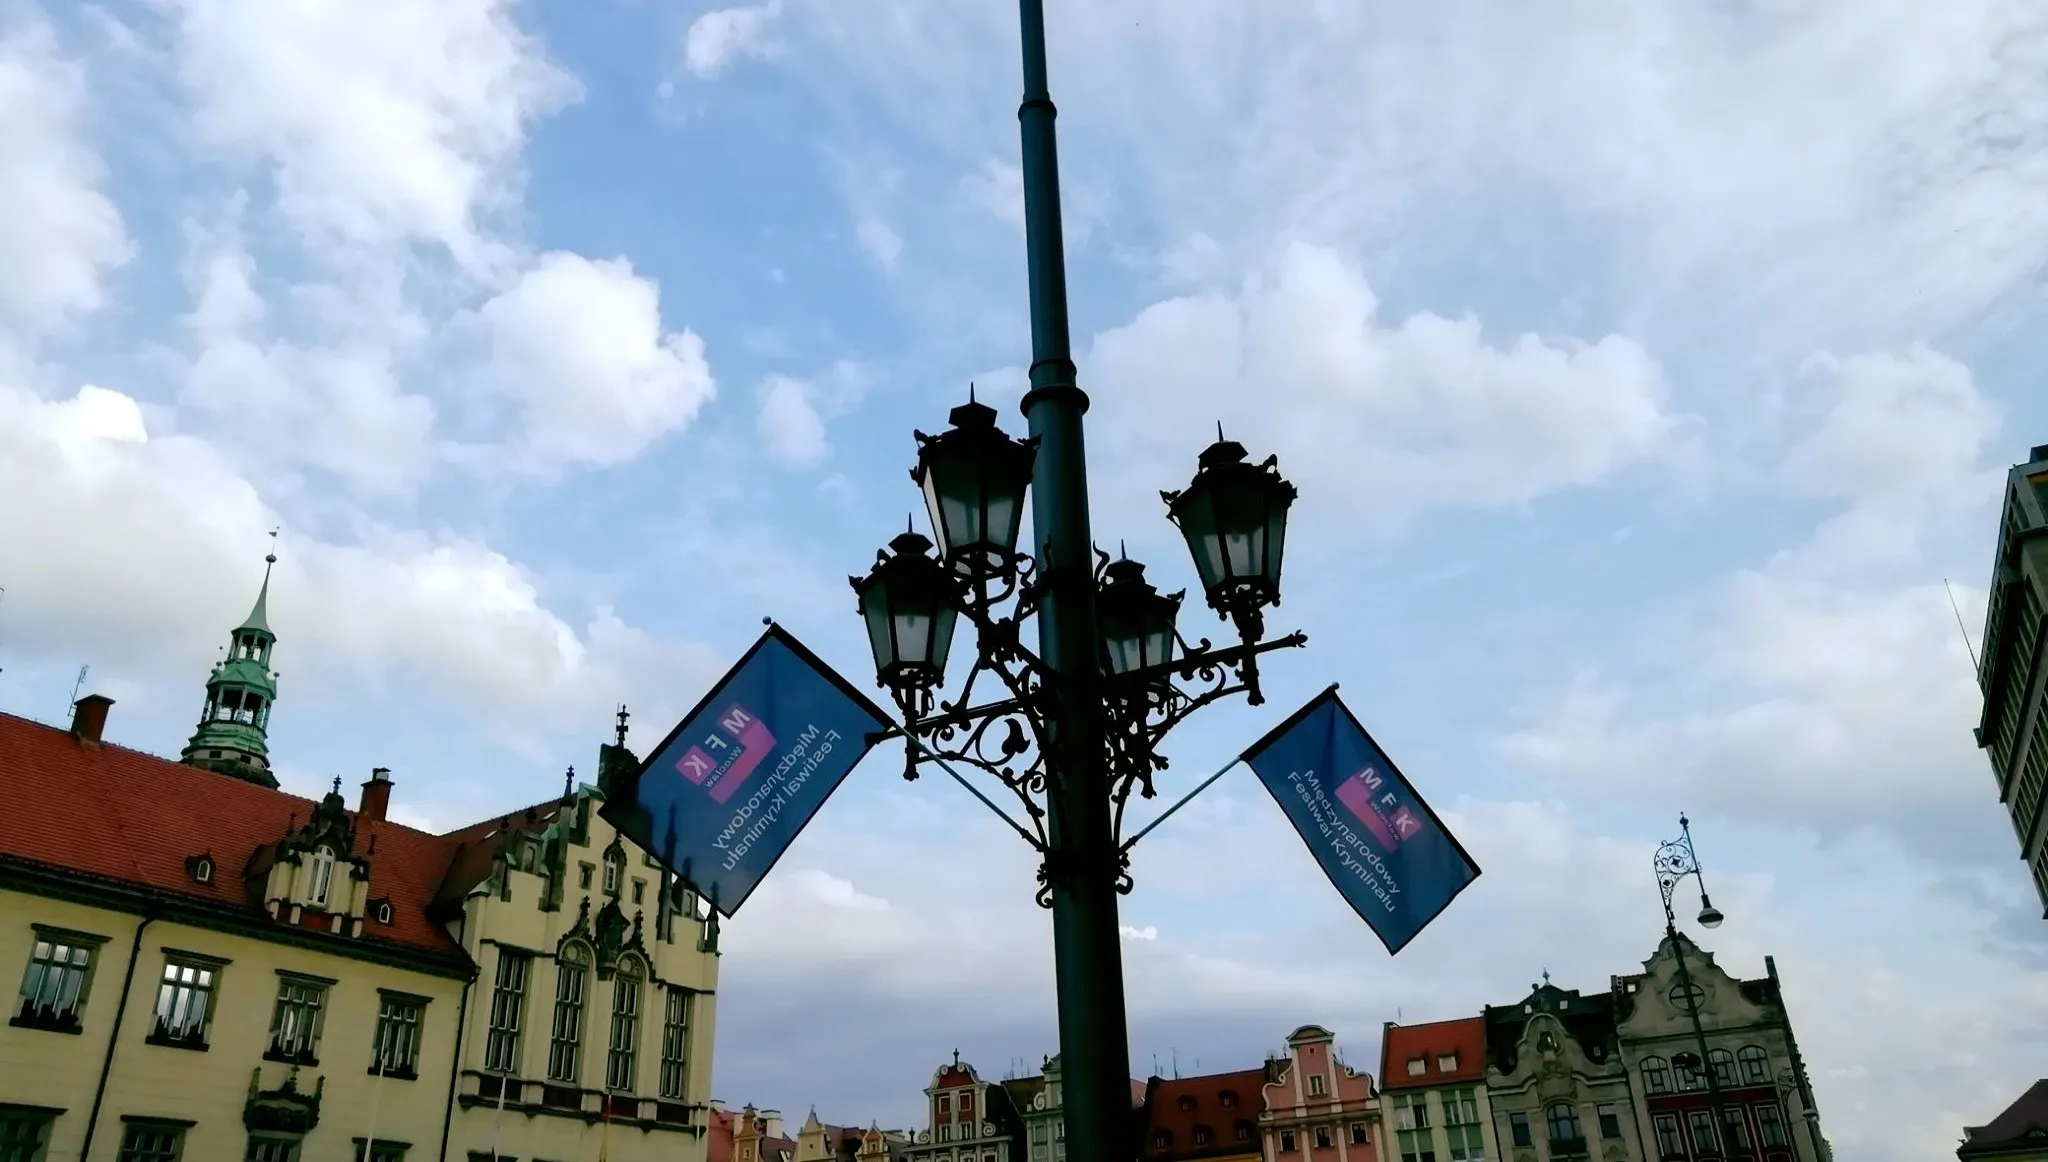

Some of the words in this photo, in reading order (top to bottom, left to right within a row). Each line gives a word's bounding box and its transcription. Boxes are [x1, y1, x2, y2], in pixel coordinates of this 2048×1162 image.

[1288, 771, 1332, 838] Festiwal
[1330, 838, 1396, 913] Kryminału
[1304, 770, 1400, 894] Międzynarodowy
